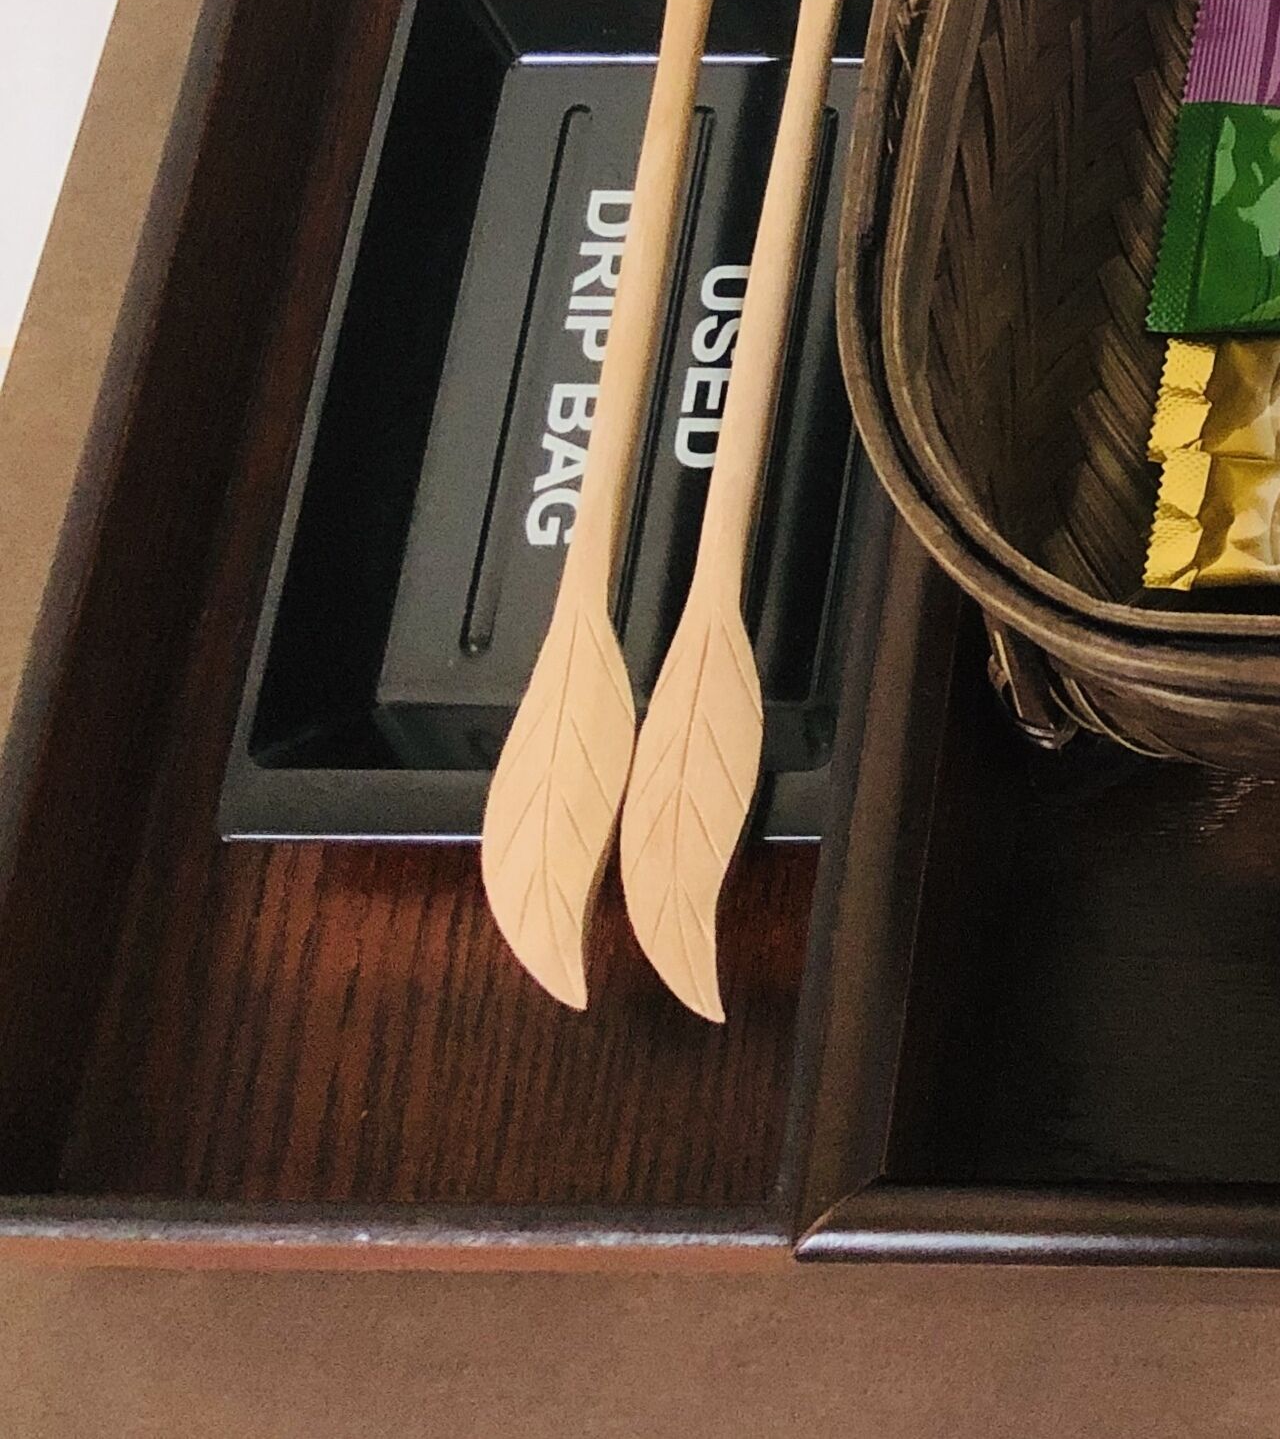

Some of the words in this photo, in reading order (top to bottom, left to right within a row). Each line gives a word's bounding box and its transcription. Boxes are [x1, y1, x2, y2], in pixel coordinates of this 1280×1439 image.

[565, 189, 636, 362] DRIP
[674, 265, 750, 469] USED
[525, 383, 602, 546] BAG
